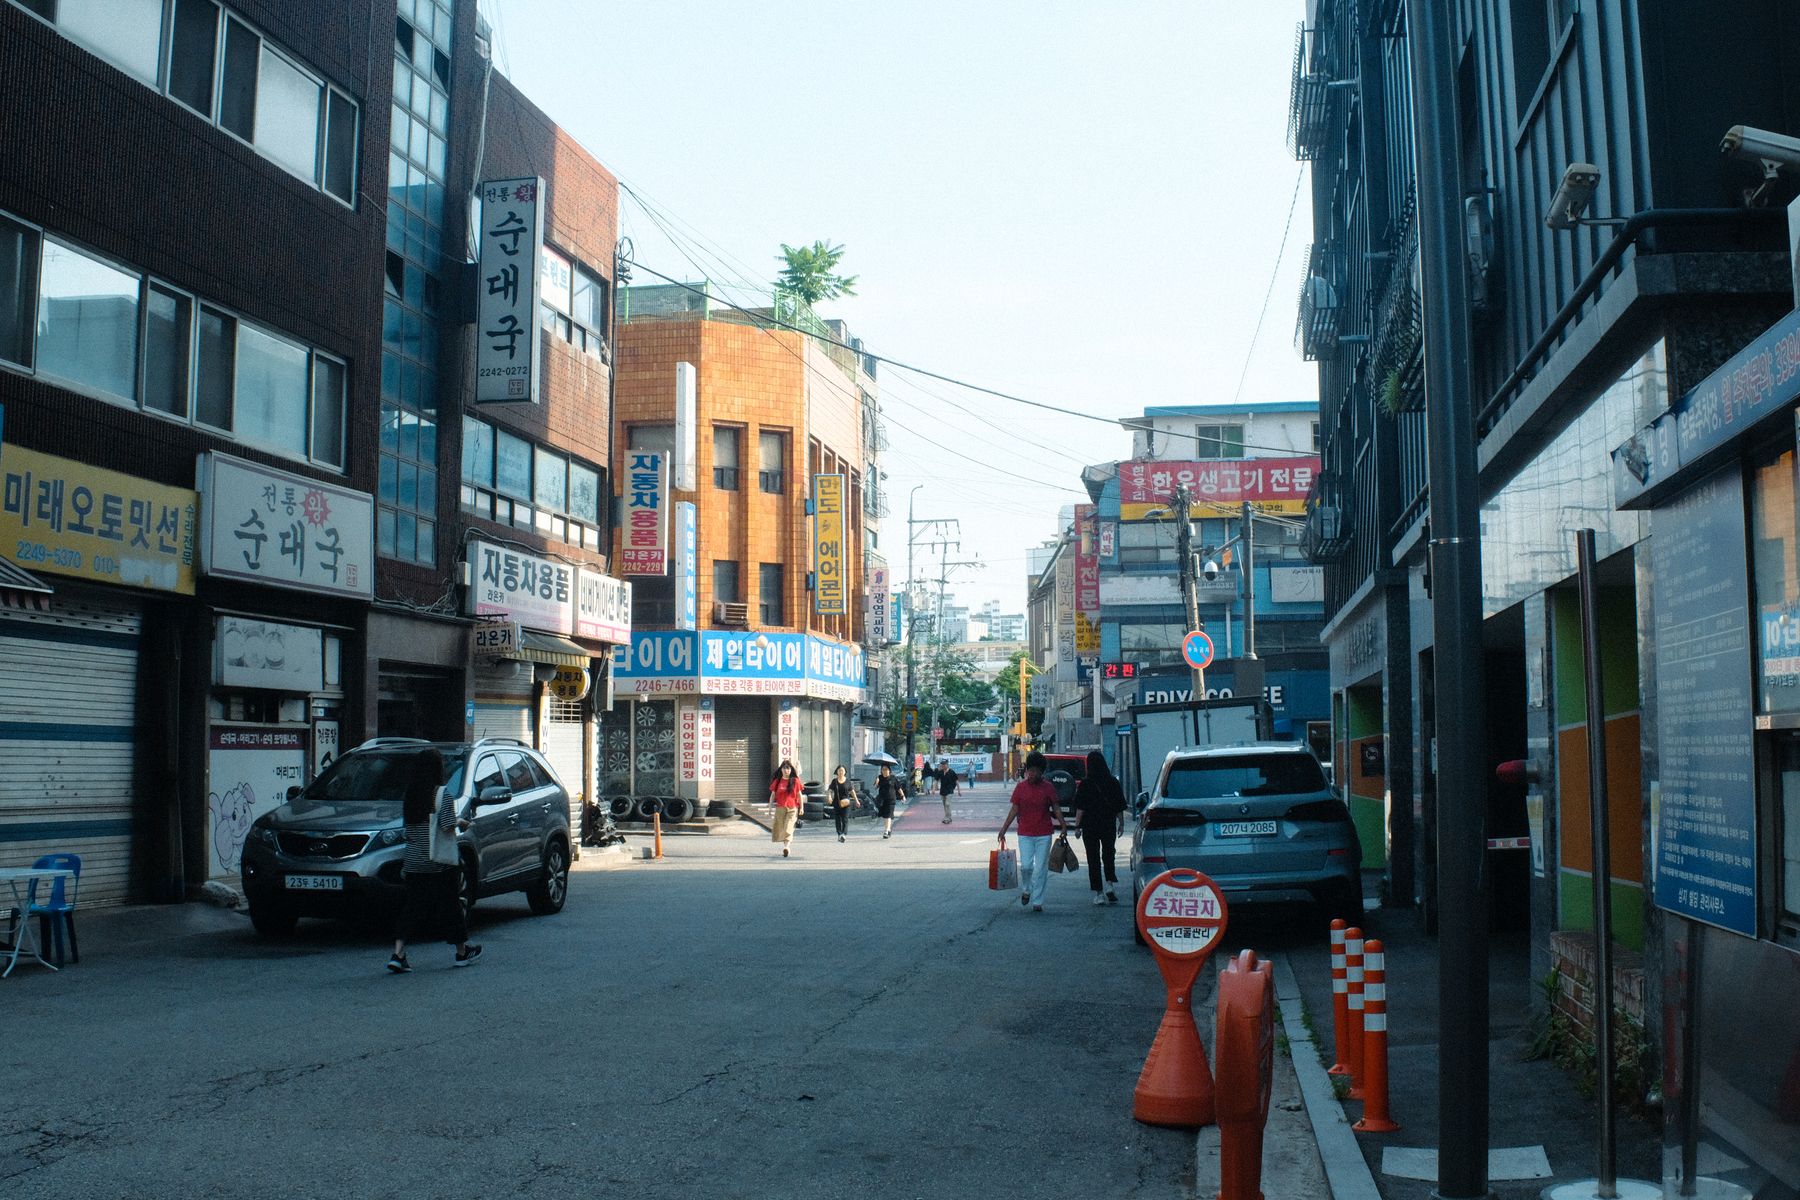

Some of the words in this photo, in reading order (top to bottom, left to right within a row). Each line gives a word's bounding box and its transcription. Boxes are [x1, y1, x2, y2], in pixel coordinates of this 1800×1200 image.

[486, 188, 510, 202] 전통
[520, 186, 533, 201] 왕
[486, 211, 527, 360] 순대국
[480, 366, 527, 377] 2242-0272
[1270, 467, 1314, 492] 전문
[4, 471, 180, 554] 미래오토밋션
[262, 484, 297, 516] 전통
[309, 496, 325, 520] 왕
[16, 540, 82, 568] 2249-5370
[234, 509, 345, 584] 순대국
[482, 548, 569, 603] 자동차용품
[476, 630, 512, 647] 라온카
[706, 638, 800, 671] 제일타이어
[810, 641, 864, 683] 제일타이어
[635, 679, 695, 692] 2246-7466
[706, 679, 721, 691] 한국
[723, 679, 737, 691] 금호
[740, 680, 754, 692] 각종
[788, 679, 801, 693] 전문
[682, 712, 695, 779] 타이어할인매장
[701, 712, 712, 779] 제일타이어
[1250, 822, 1275, 834] 2085
[313, 878, 338, 888] 5410
[1153, 897, 1215, 918] 주차금지
